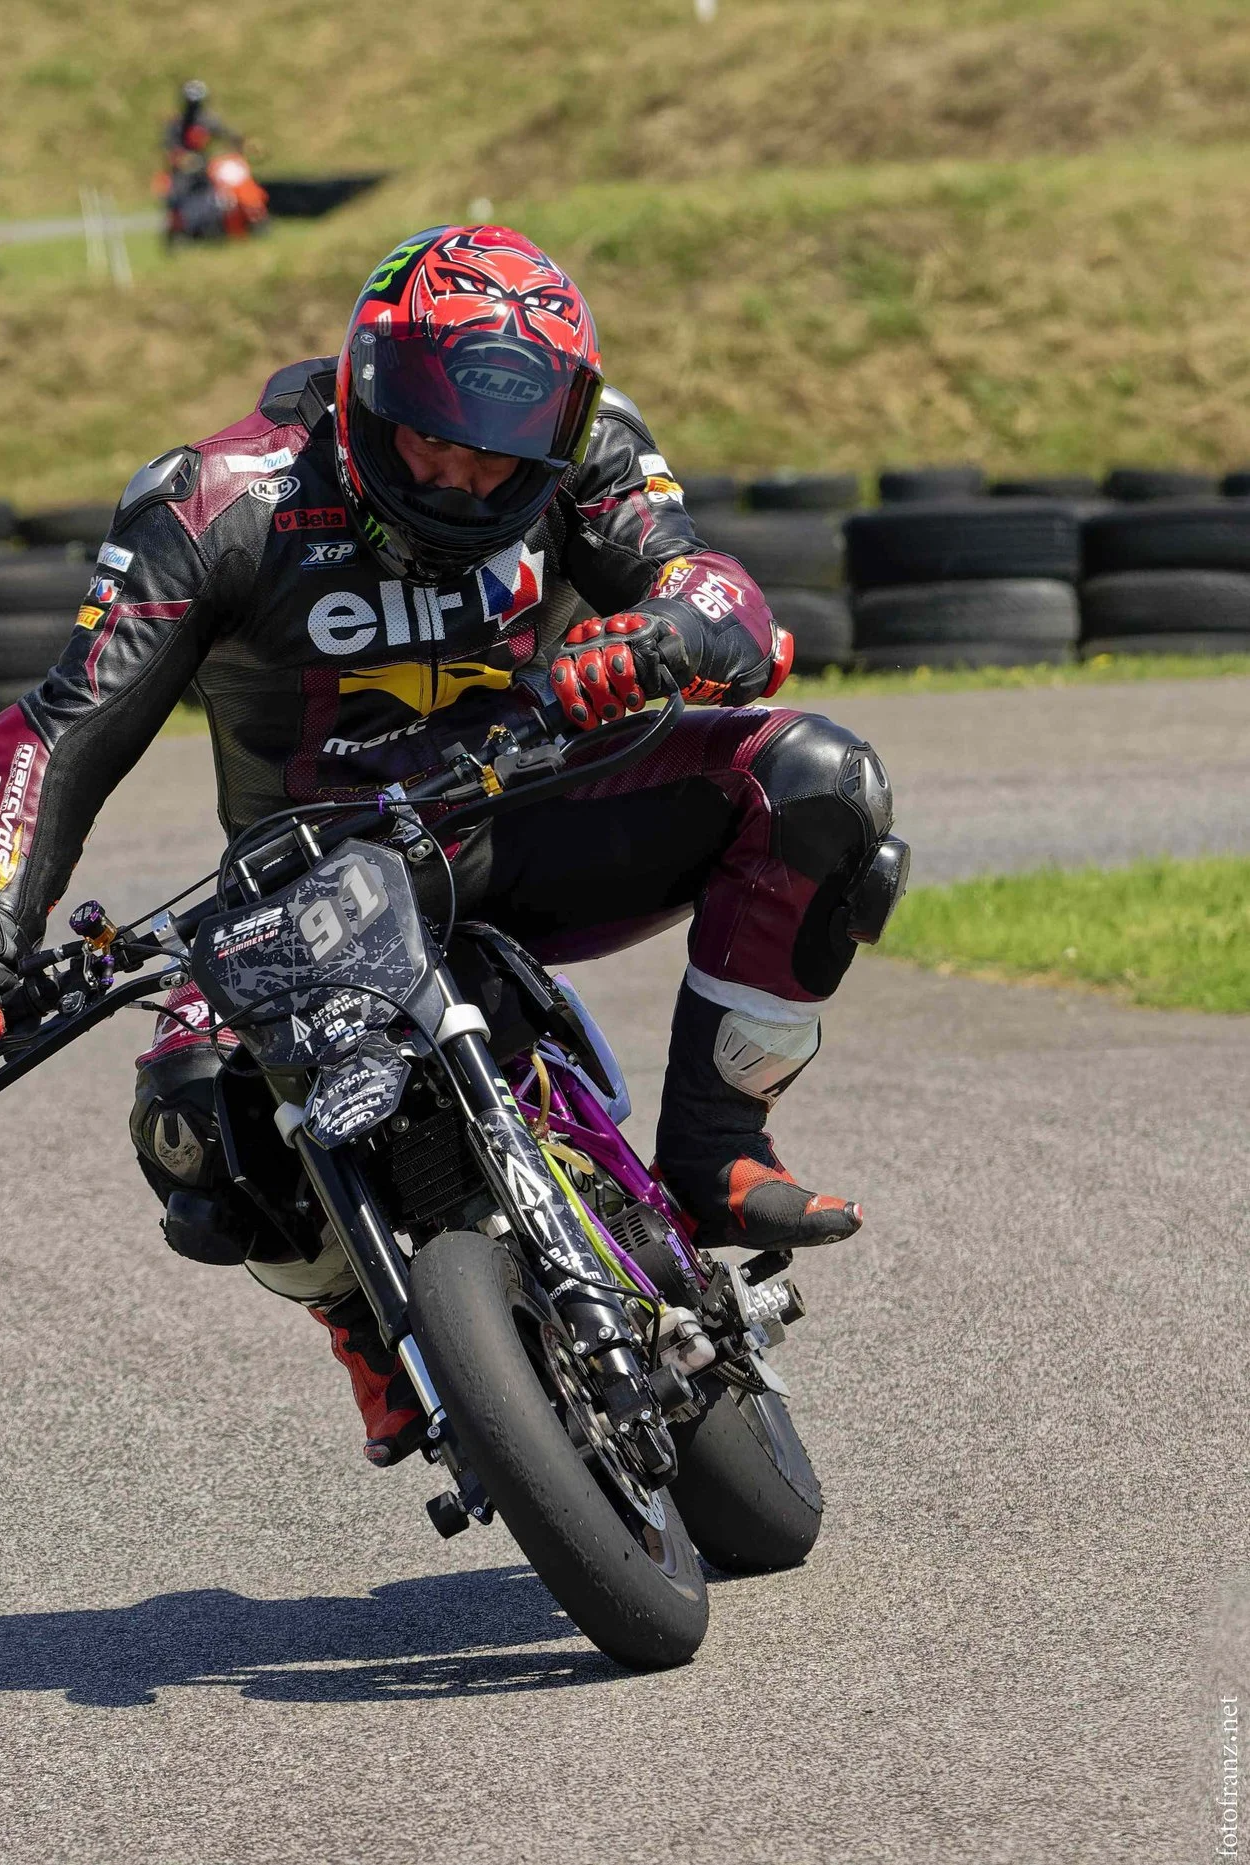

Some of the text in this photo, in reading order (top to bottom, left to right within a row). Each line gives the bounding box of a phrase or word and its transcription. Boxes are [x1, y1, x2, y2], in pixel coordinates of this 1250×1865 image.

[458, 370, 540, 398] HJC
[295, 510, 342, 528] Beta
[214, 907, 283, 944] LS2
[300, 864, 379, 962] 91
[214, 919, 282, 952] HELMETS
[223, 936, 264, 956] KUMMER
[311, 994, 351, 1022] XPEAR
[314, 994, 370, 1029] PITBIKES
